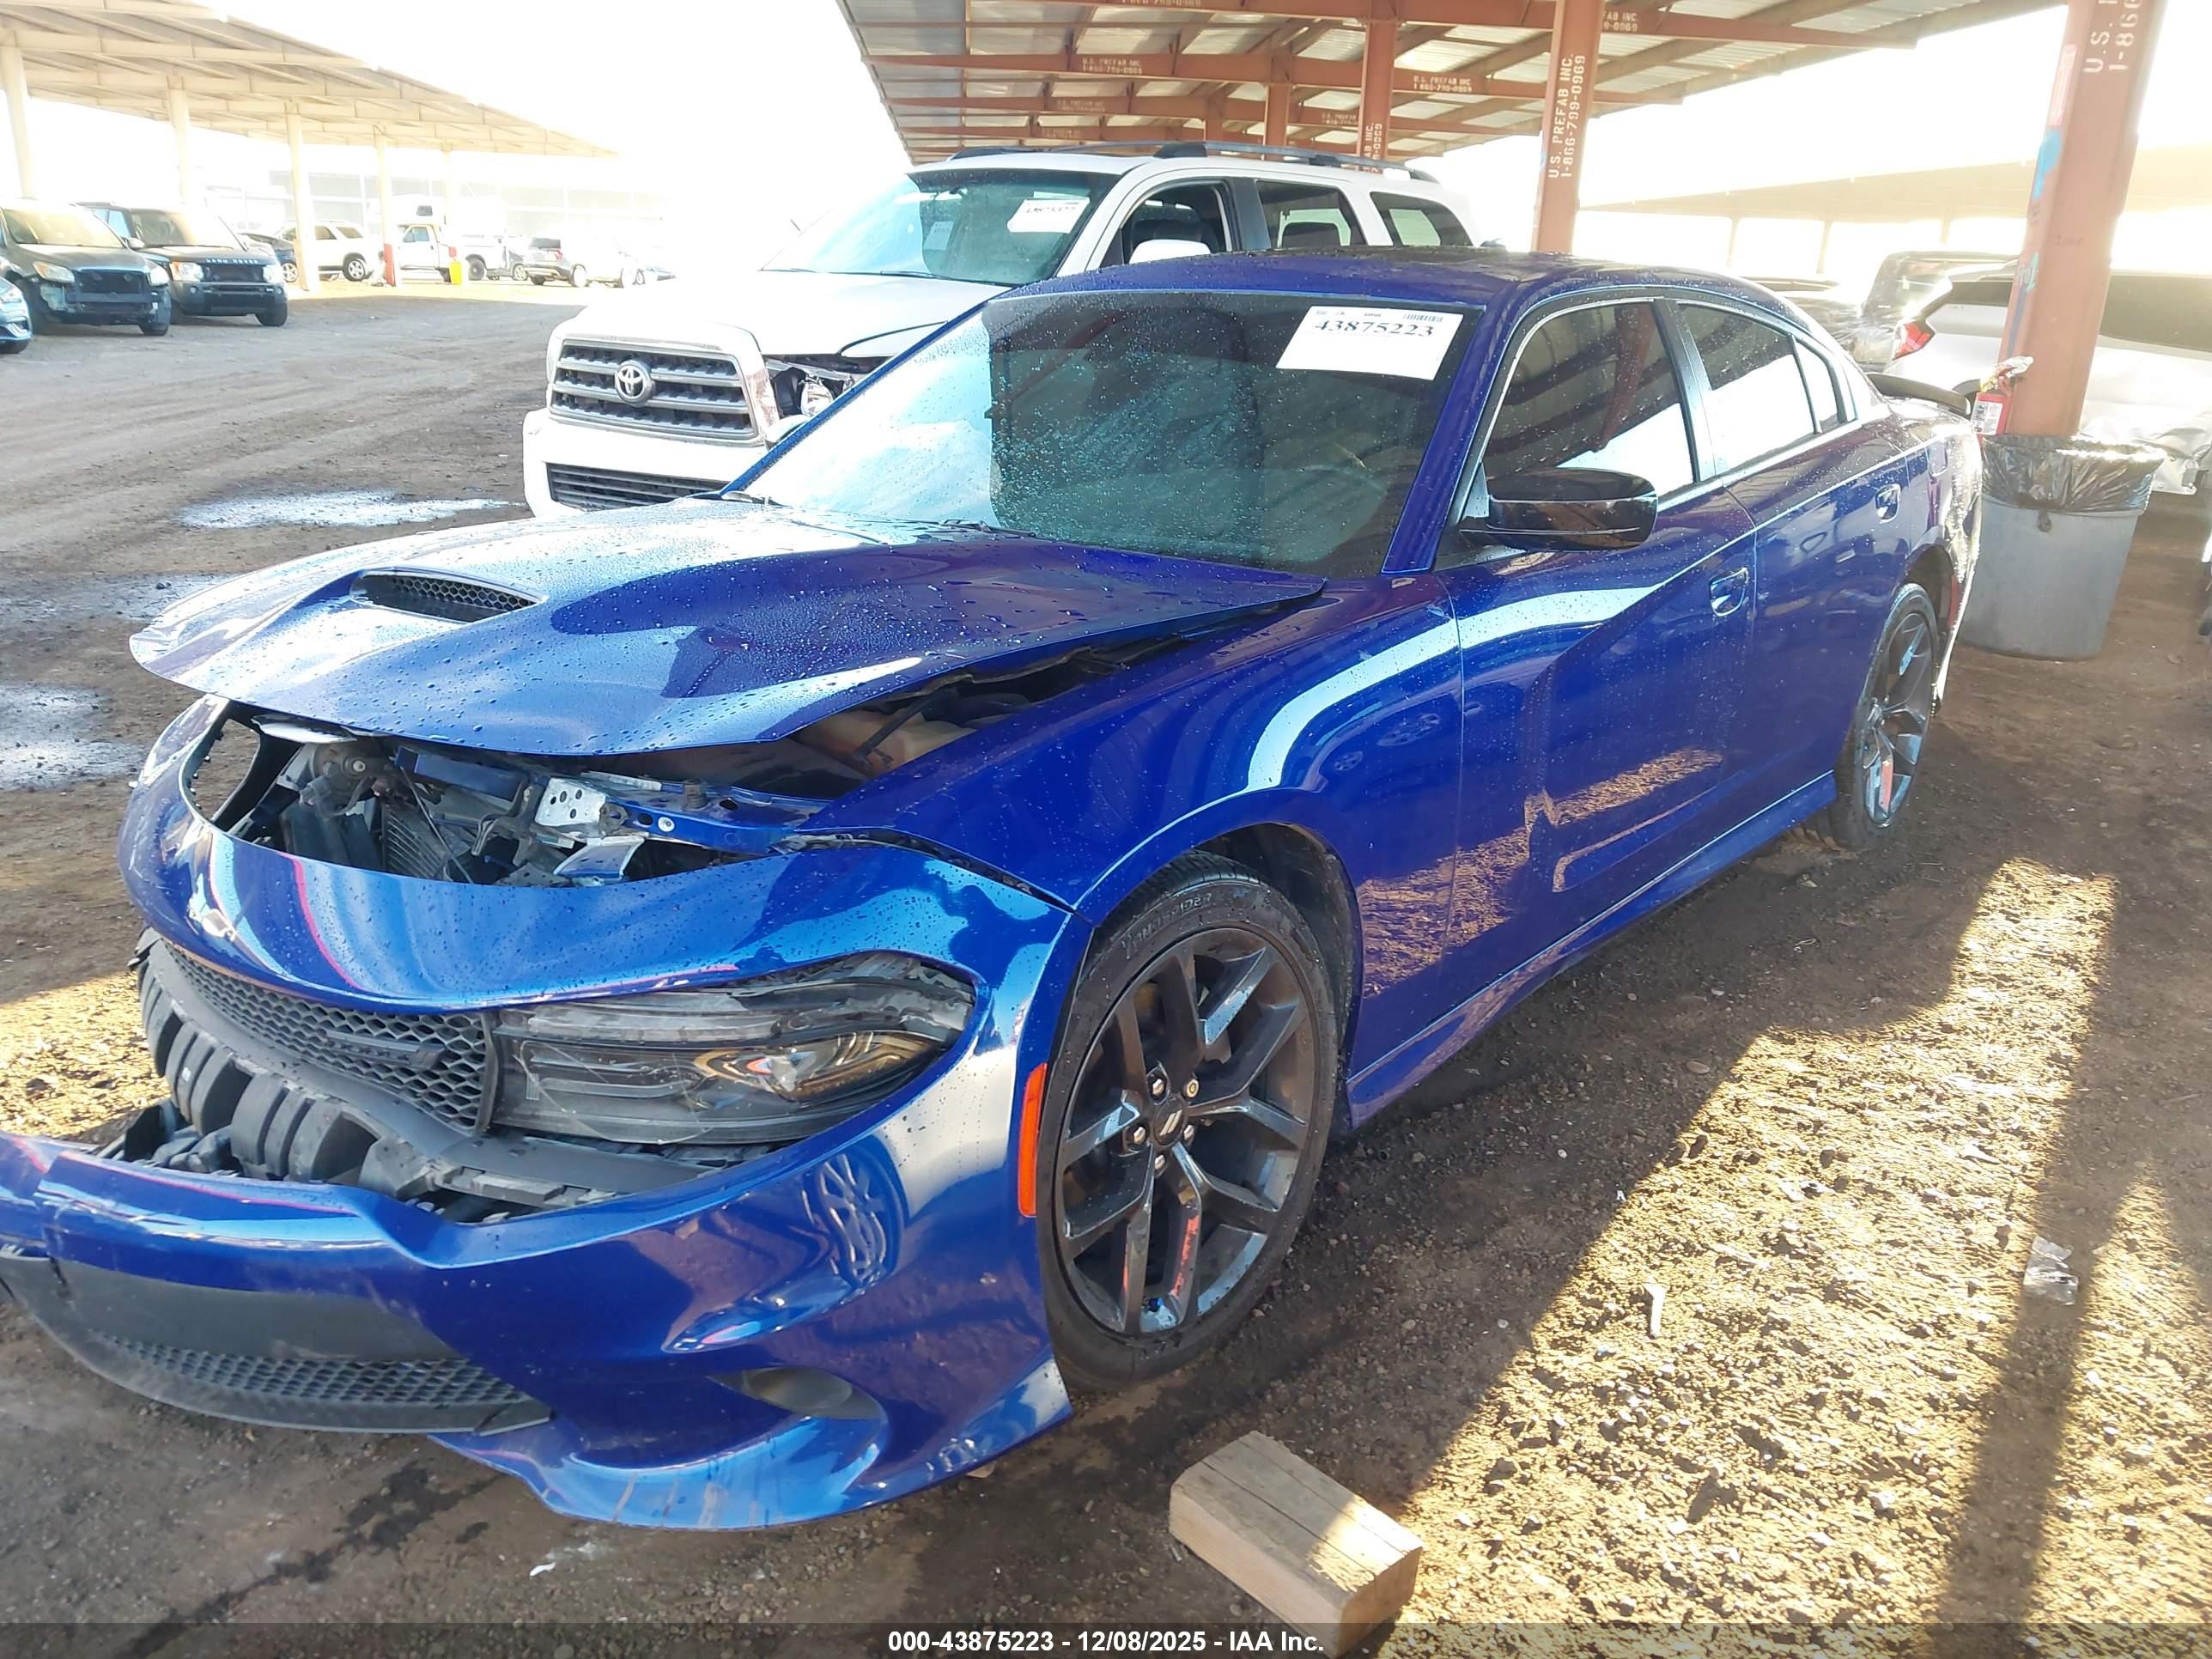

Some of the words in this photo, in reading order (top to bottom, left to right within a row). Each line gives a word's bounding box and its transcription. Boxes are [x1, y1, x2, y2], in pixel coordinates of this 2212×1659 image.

[1559, 53, 1575, 82] INC.
[2082, 22, 2113, 73] U.S.
[1552, 88, 1570, 144] PREFAB
[1560, 55, 1586, 178] 1-866-799-0969
[1548, 151, 1563, 179] U.S.
[1315, 319, 1436, 337] 43875223
